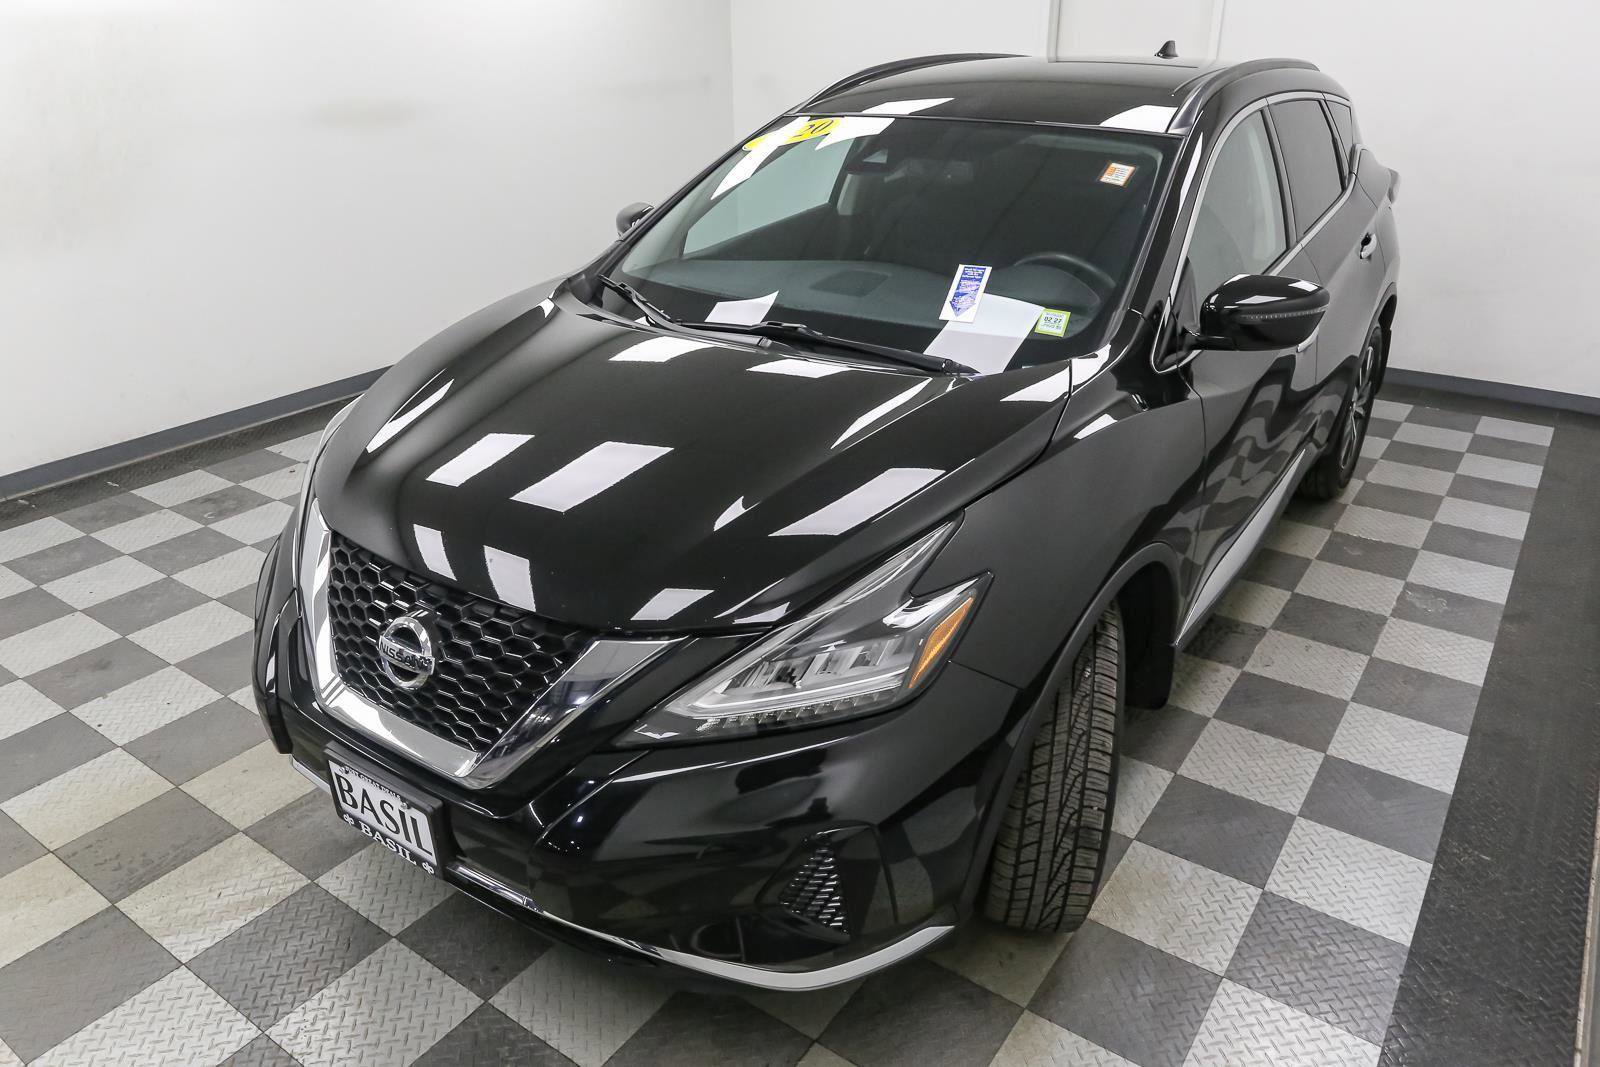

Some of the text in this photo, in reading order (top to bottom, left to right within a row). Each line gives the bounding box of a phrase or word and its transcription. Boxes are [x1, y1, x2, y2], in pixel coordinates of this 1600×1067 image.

[379, 641, 432, 671] NISSAN
[334, 772, 433, 857] BASIL
[358, 820, 417, 866] BASIL
